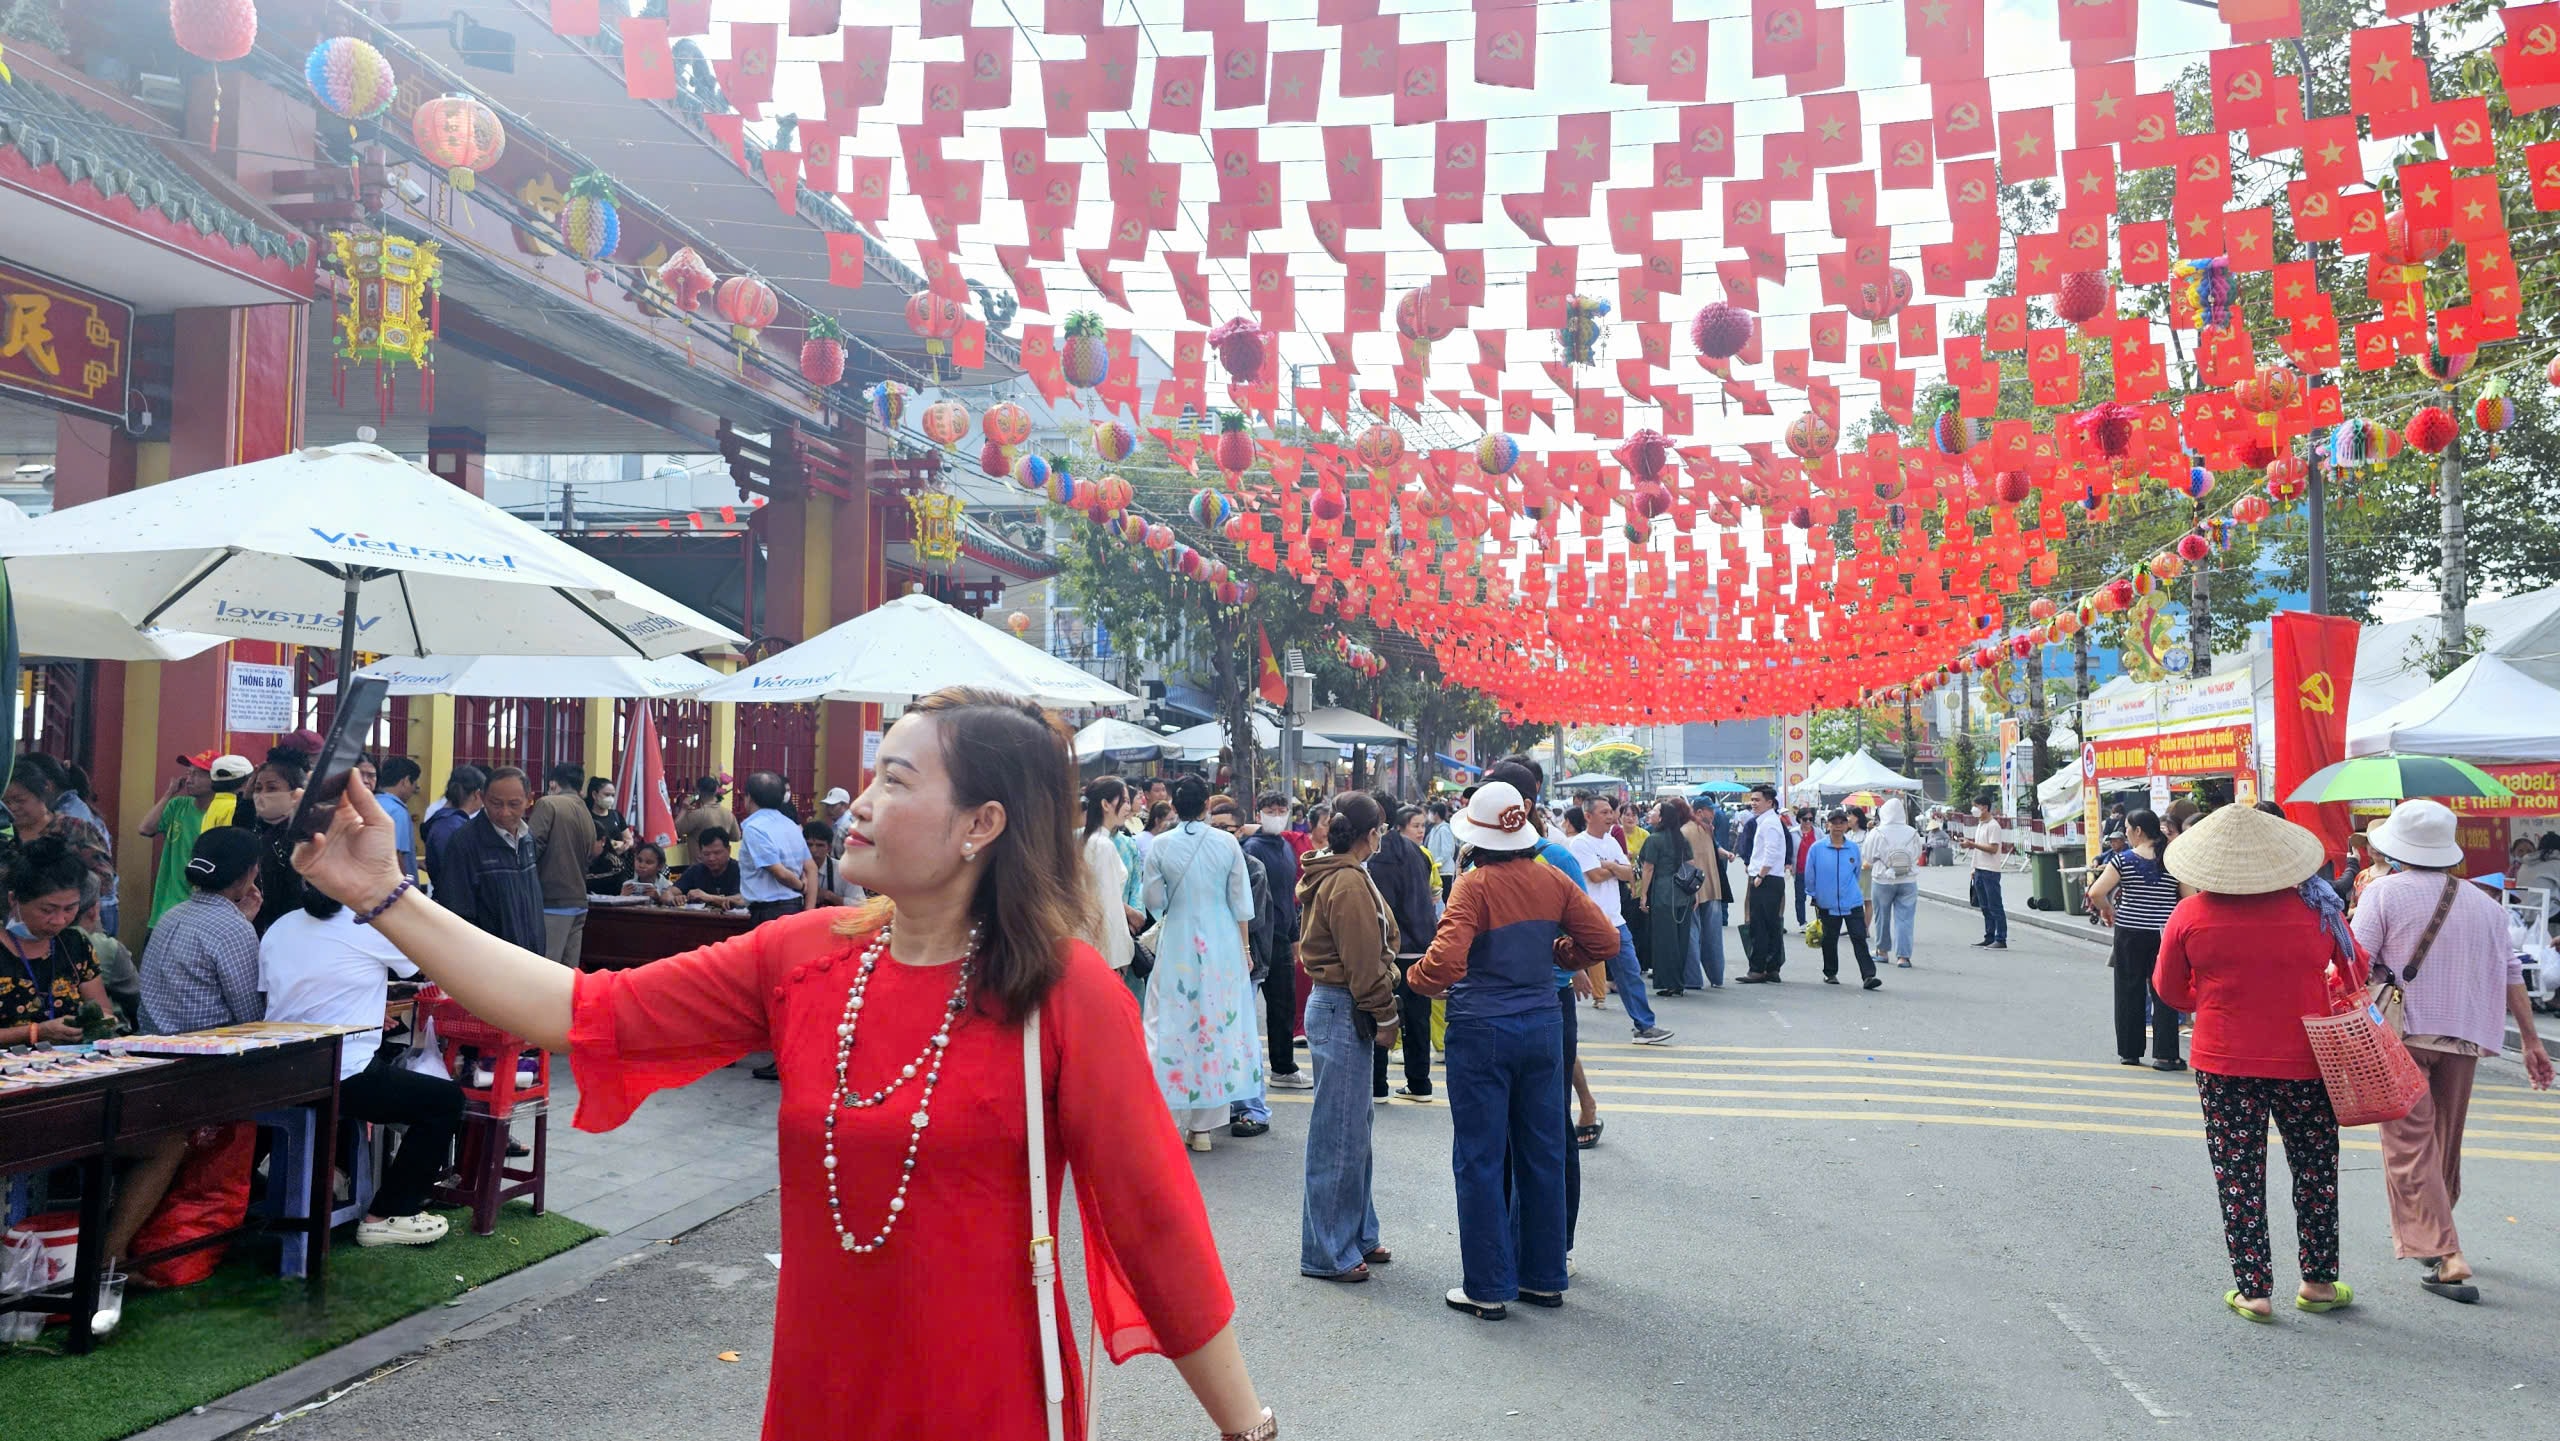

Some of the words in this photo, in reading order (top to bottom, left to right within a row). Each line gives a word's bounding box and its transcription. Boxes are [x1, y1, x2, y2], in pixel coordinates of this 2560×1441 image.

[3, 294, 60, 375] 民
[309, 527, 517, 569] Vietravel
[238, 673, 264, 687] THÔNG
[265, 675, 283, 688] BÁO
[753, 671, 839, 688] Vietravel
[2500, 772, 2555, 791] nabati
[2467, 828, 2490, 849] 2026
